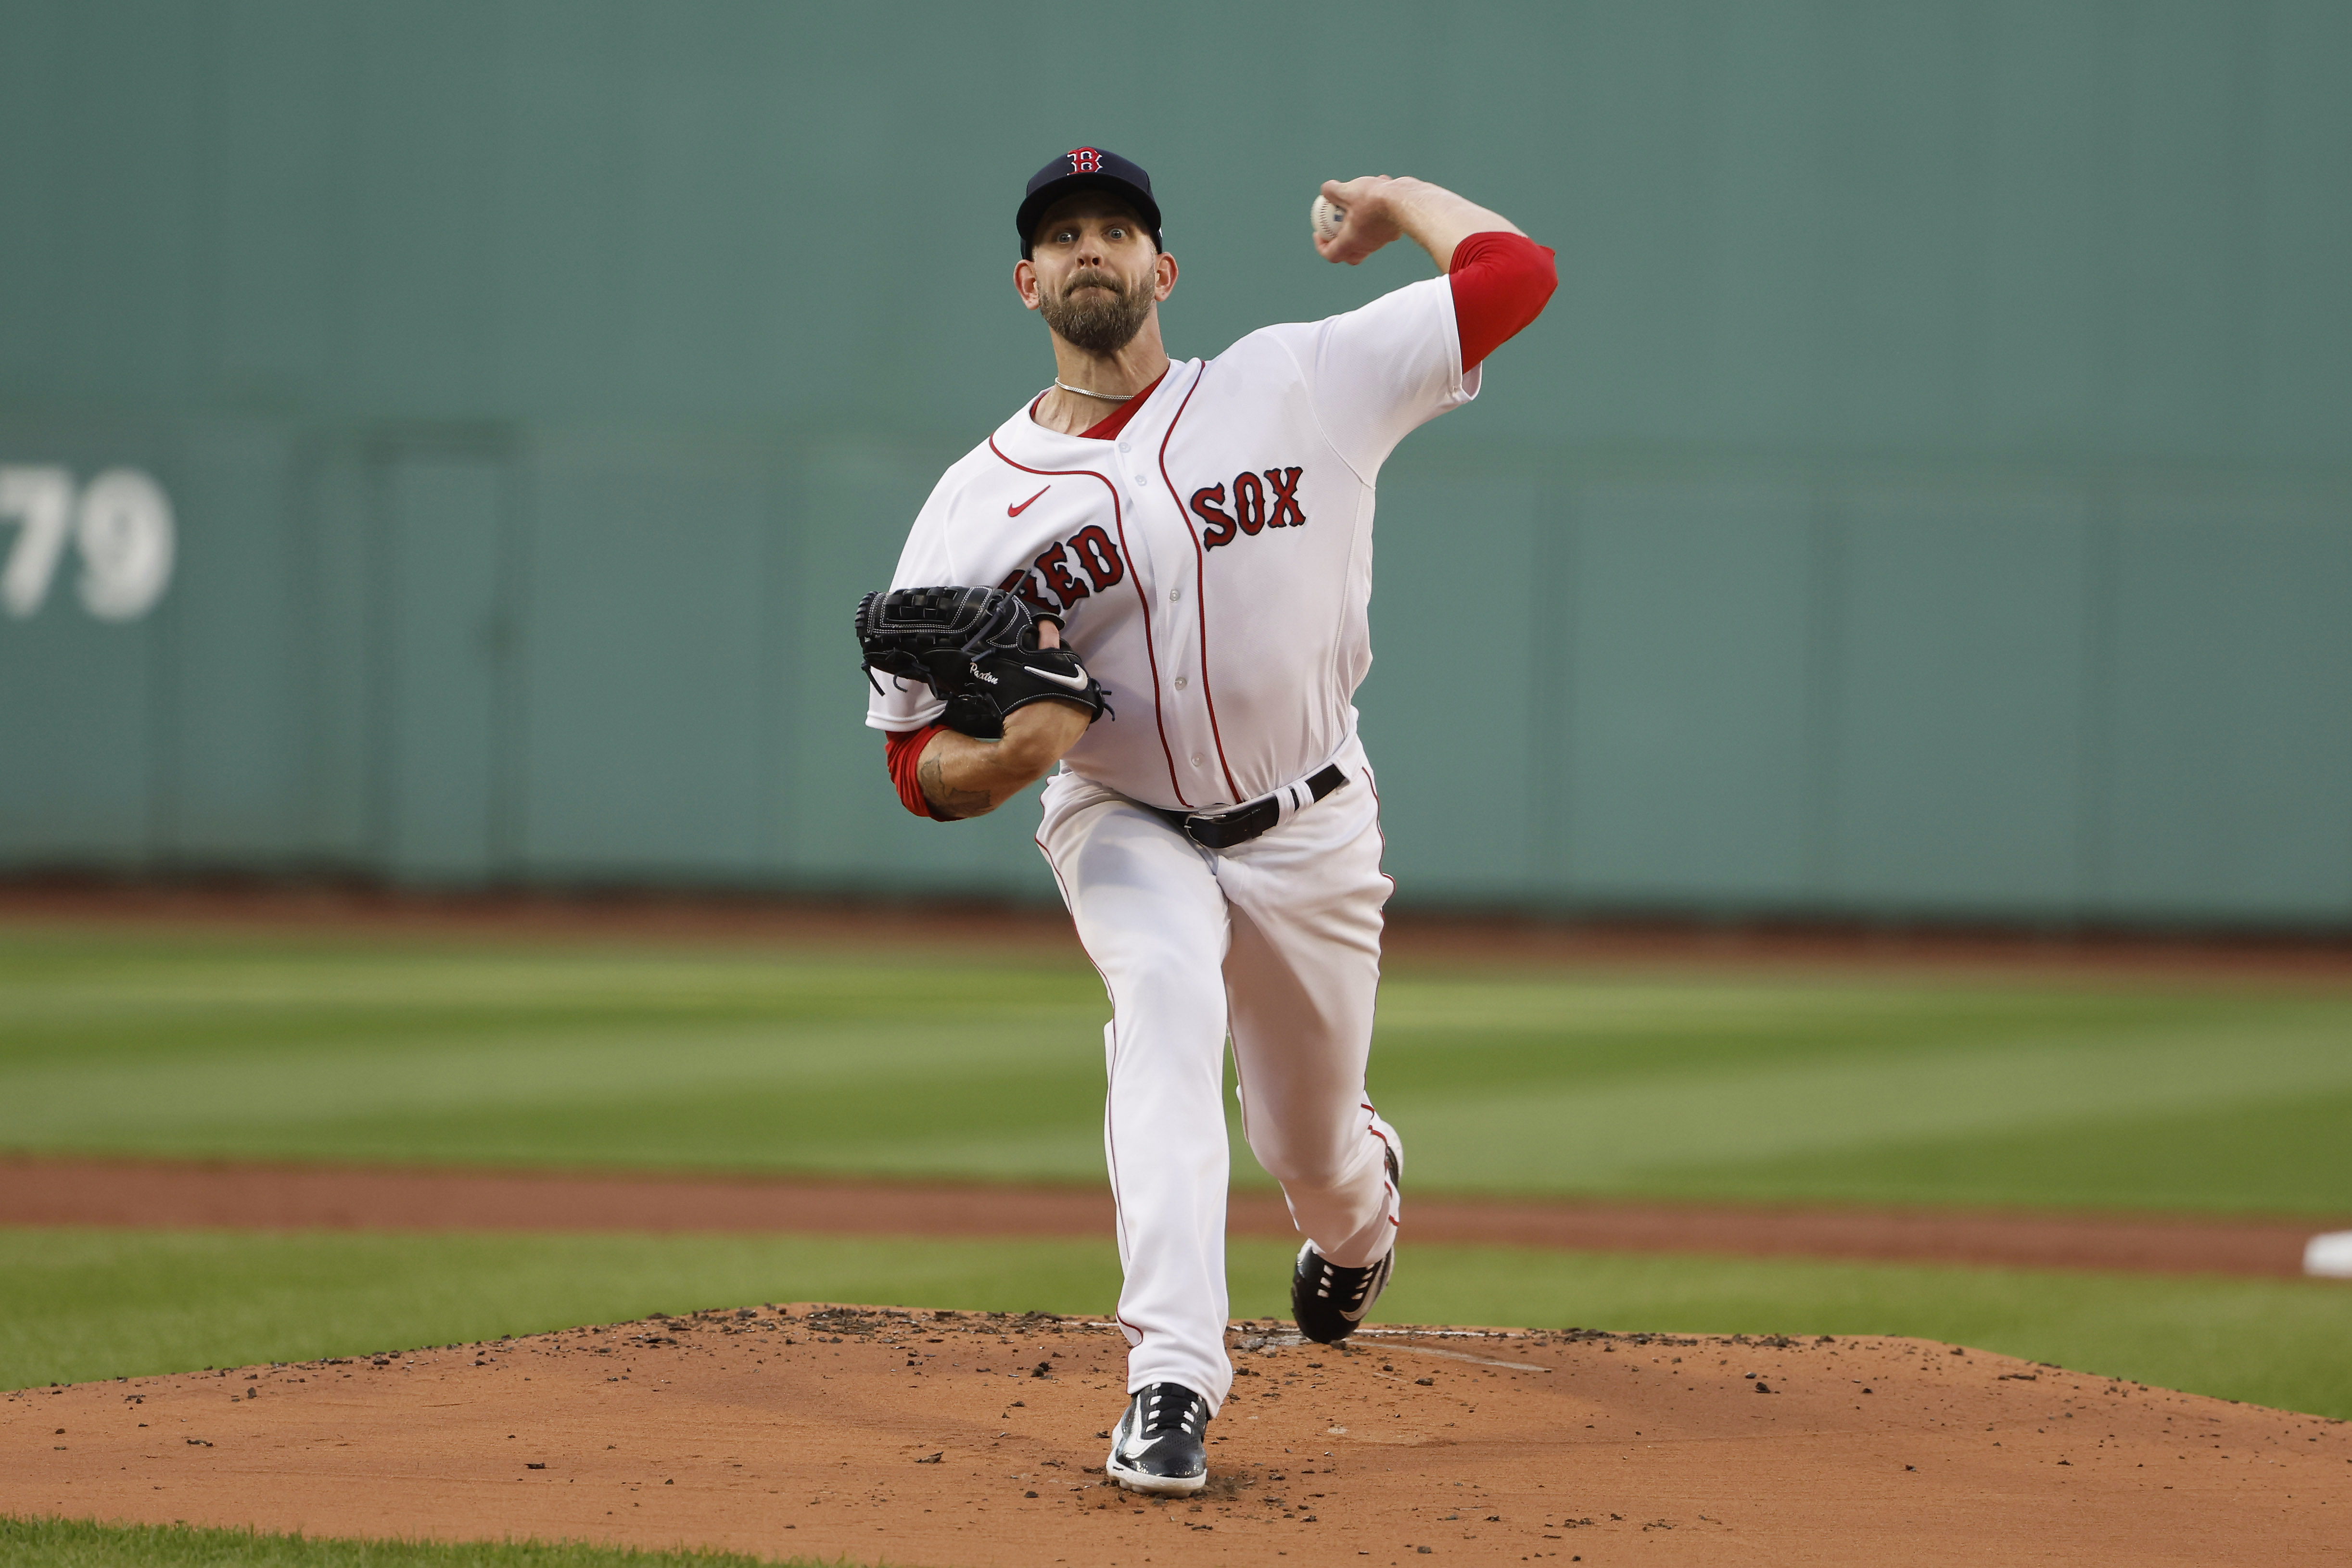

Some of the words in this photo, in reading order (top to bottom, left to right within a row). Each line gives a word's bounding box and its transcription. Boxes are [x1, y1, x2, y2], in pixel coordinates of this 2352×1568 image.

[1067, 147, 1103, 176] B
[1190, 466, 1306, 552] SOX
[0, 464, 175, 620] 79
[969, 662, 999, 684] Paxton
